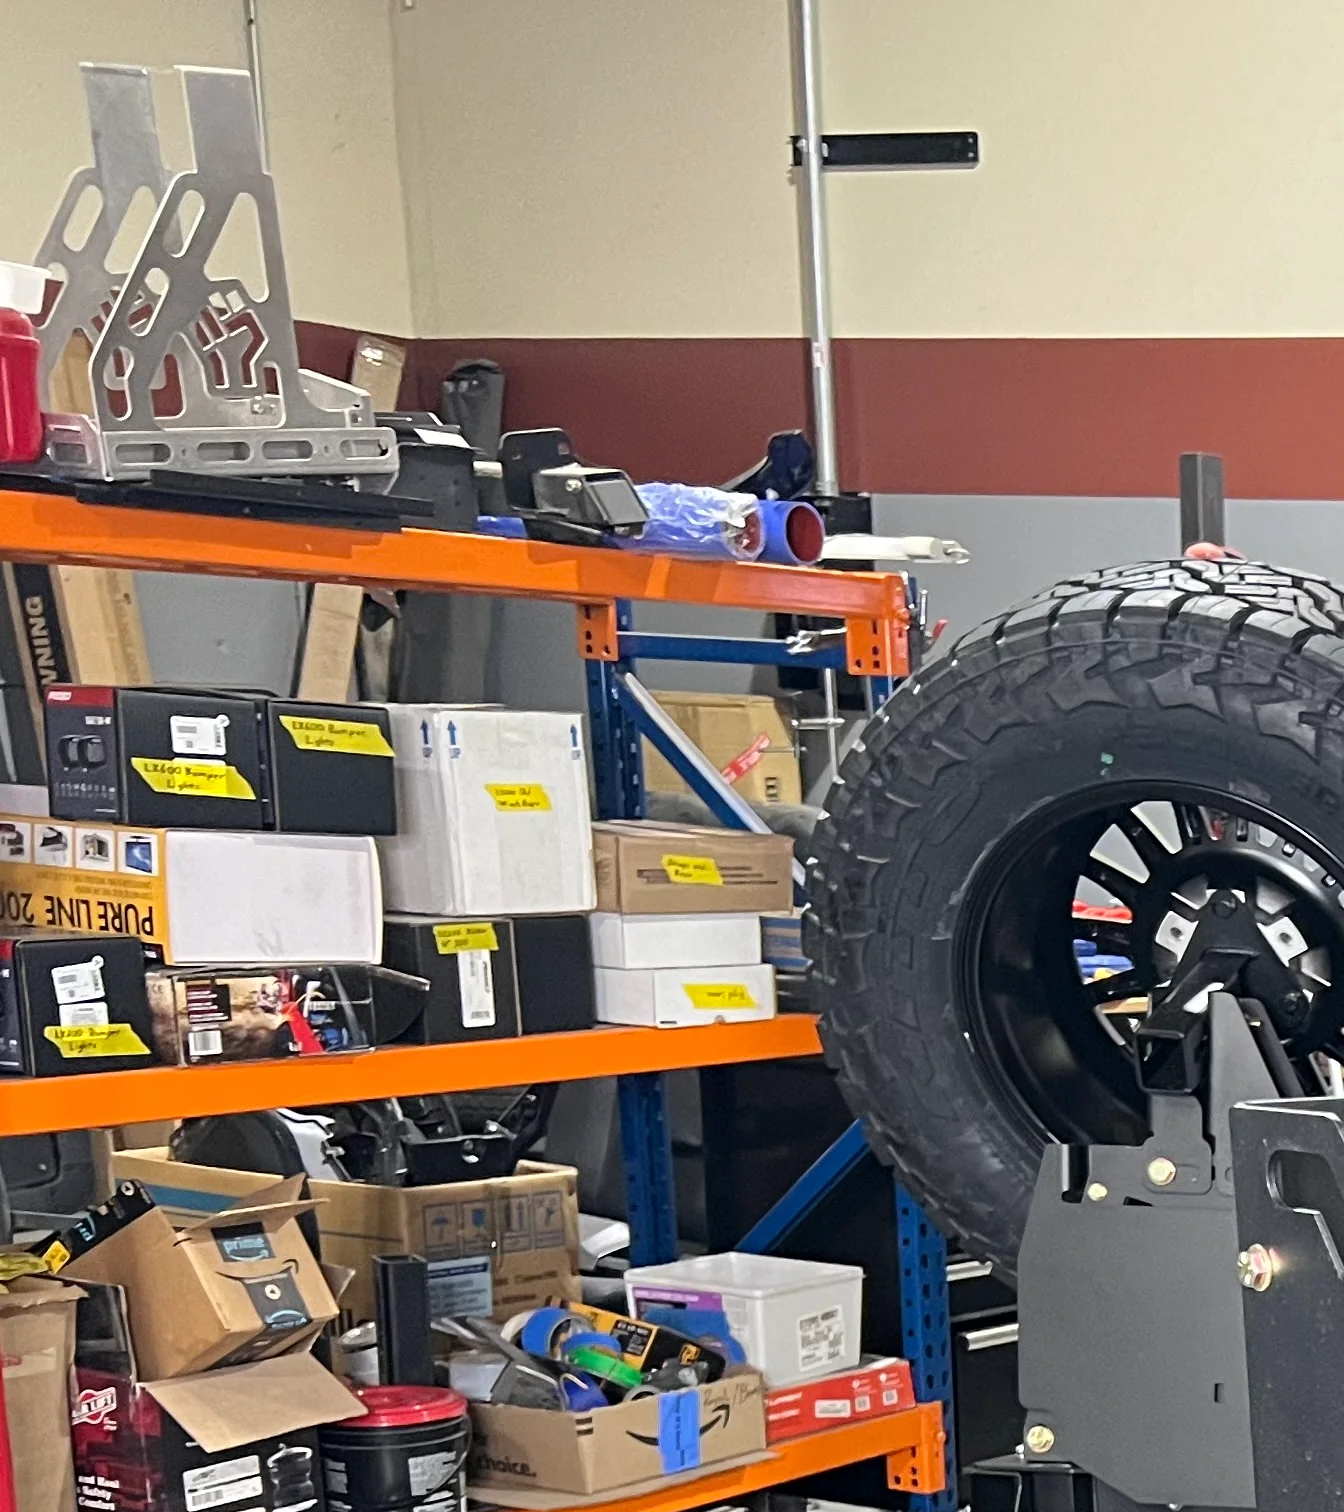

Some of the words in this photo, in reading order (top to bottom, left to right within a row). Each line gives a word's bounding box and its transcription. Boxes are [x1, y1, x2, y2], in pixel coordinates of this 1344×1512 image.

[143, 763, 182, 775] LX600
[185, 767, 227, 781] Bumper
[44, 895, 93, 930] LINE
[97, 900, 155, 937] PURE
